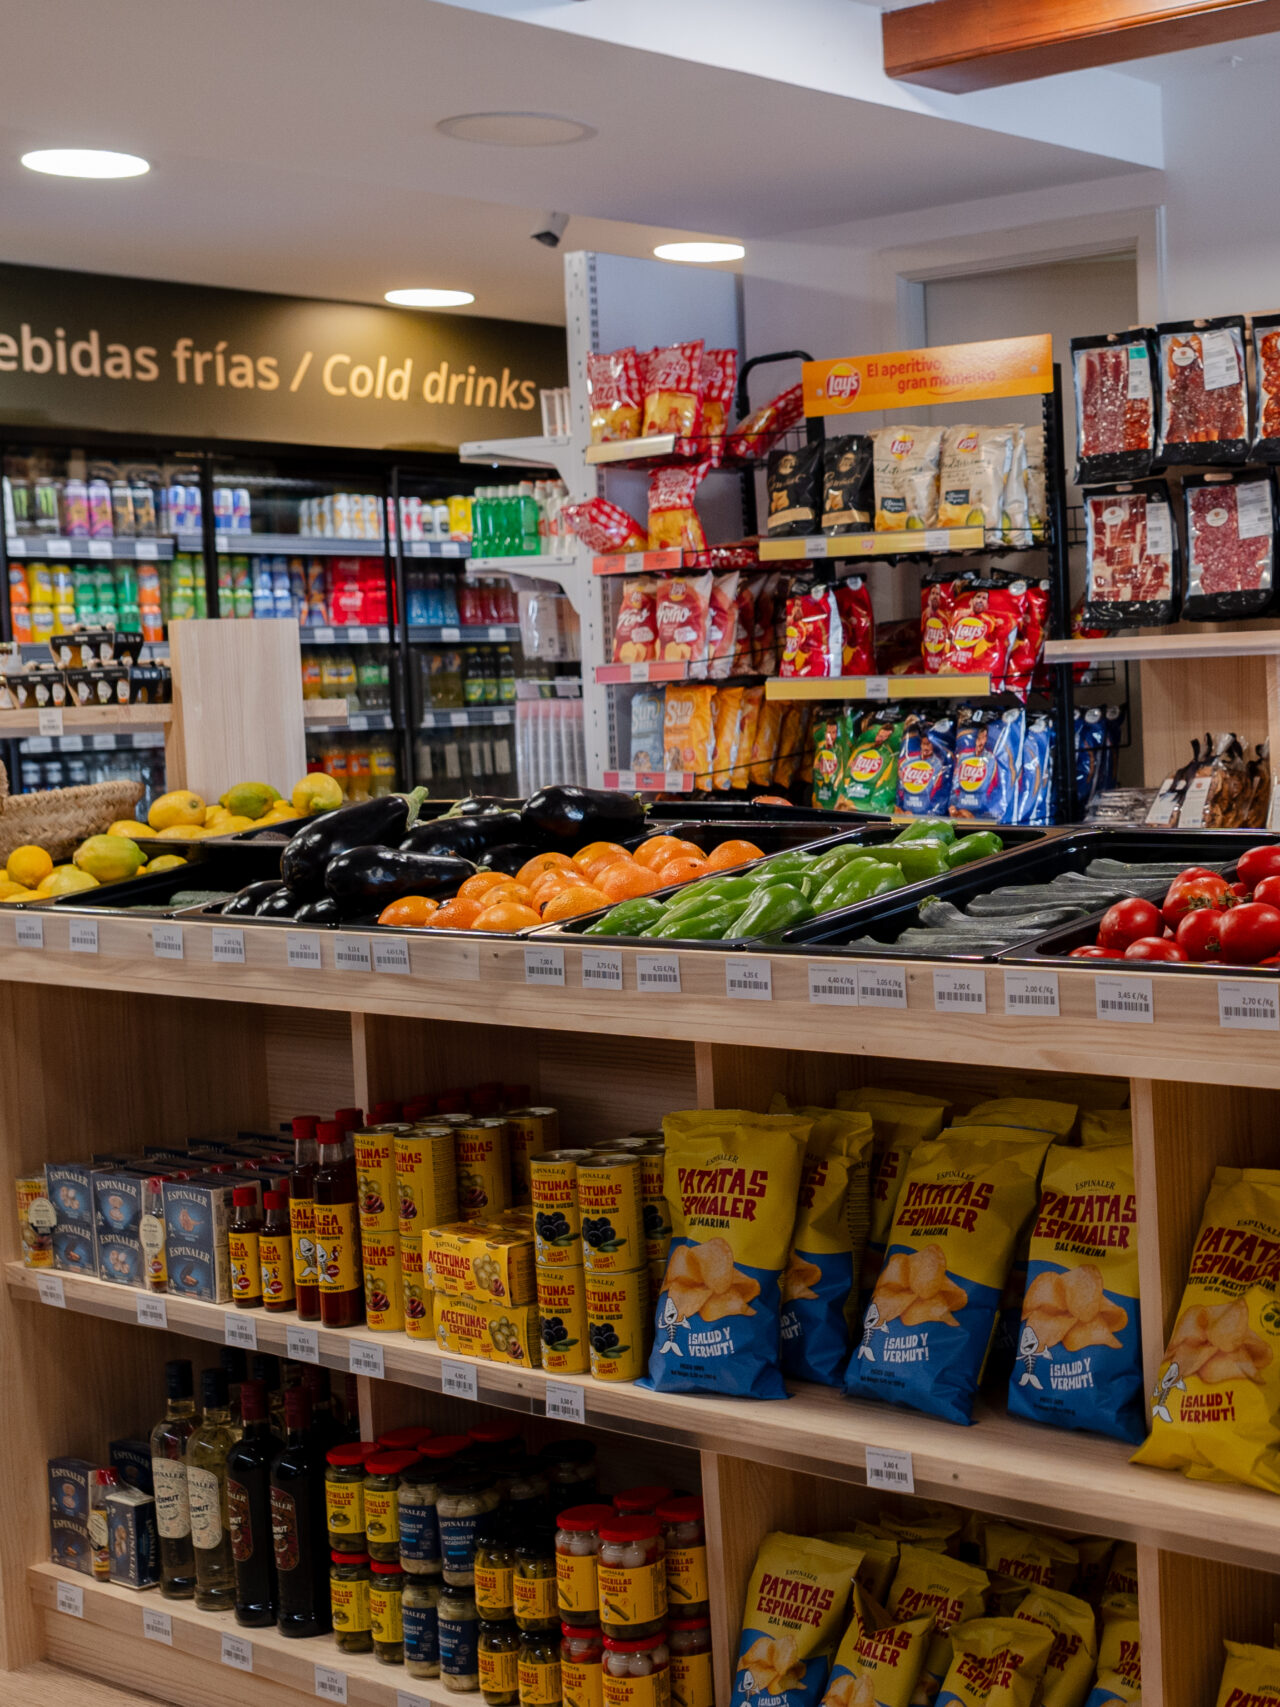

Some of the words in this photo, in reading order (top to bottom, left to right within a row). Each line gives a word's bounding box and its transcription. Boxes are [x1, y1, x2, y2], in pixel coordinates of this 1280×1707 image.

[173, 338, 280, 391] frías
[322, 352, 413, 400] Cold
[422, 361, 536, 410] drinks
[867, 363, 879, 378] El
[898, 376, 927, 394] gran
[1025, 985, 1038, 993] 2,00
[1118, 992, 1131, 1000] 3,45
[50, 1171, 88, 1188] ESPINALER
[678, 1167, 768, 1198] PATATAS
[1075, 1180, 1116, 1191] ESPINALER
[96, 1180, 138, 1199] ESPINALER
[167, 1190, 208, 1208] ESPINALER
[904, 1181, 994, 1211] PATATAS
[681, 1196, 757, 1222] SPINALER
[1039, 1191, 1137, 1223] PATATAS
[896, 1206, 978, 1233] ESPINALER
[100, 1234, 140, 1252] ESPINALER
[1033, 1217, 1130, 1250] ESPINALER
[169, 1246, 210, 1264] ESPINALER
[1054, 1241, 1069, 1252] SAL
[1070, 1243, 1107, 1258] MARINA
[429, 1250, 470, 1271] ACEITUNAS
[436, 1265, 466, 1280] ESPINALER
[441, 1310, 487, 1330] ACEITUNAS
[450, 1324, 483, 1340] ESPINALER
[688, 1330, 722, 1345] ¡SALUD
[723, 1326, 730, 1340] Y
[884, 1335, 918, 1350] ¡SALUD
[920, 1332, 928, 1346] Y
[688, 1340, 735, 1357] VERMUT!
[883, 1346, 929, 1363] VERMUT!
[1050, 1360, 1083, 1377] ¡SALUD
[1084, 1357, 1091, 1371] Y
[1050, 1372, 1094, 1391] VERMUT!
[1181, 1392, 1223, 1409] ¡SALUD
[1225, 1390, 1234, 1406] Y
[1180, 1406, 1235, 1423] VERMUT!
[51, 1468, 86, 1488] ESPINALER
[759, 1573, 835, 1611] PATATAS
[757, 1595, 823, 1628] ESPINALER
